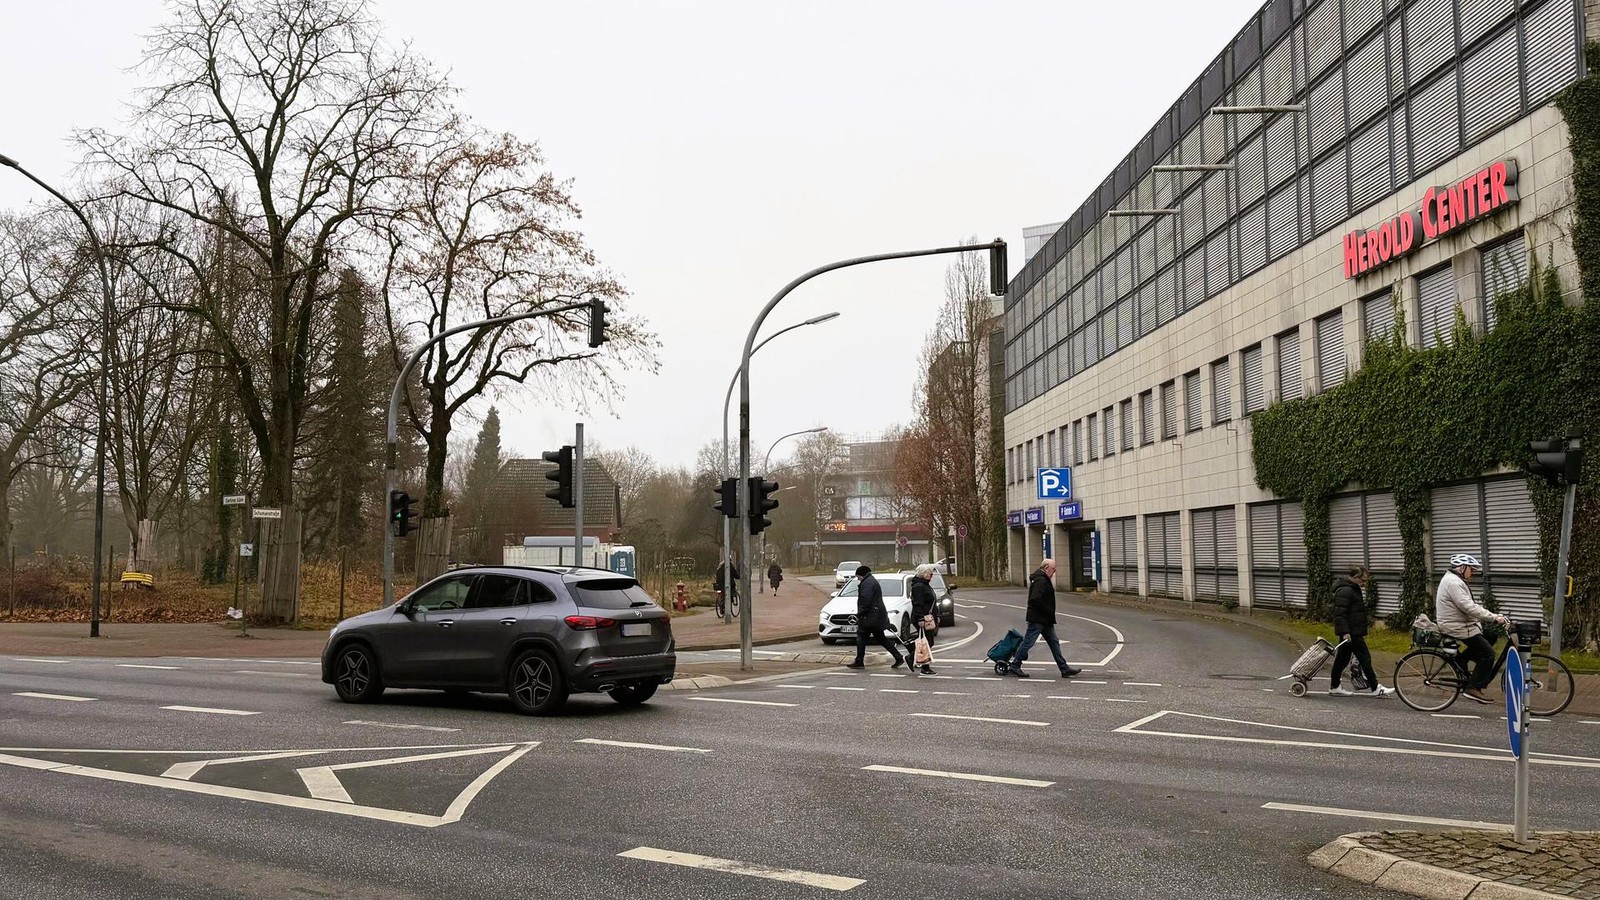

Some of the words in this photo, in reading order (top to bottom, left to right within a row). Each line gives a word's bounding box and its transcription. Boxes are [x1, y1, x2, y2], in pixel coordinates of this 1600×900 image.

[1343, 211, 1414, 280] HEROLD
[1422, 161, 1509, 239] CENTER
[1042, 475, 1060, 496] P
